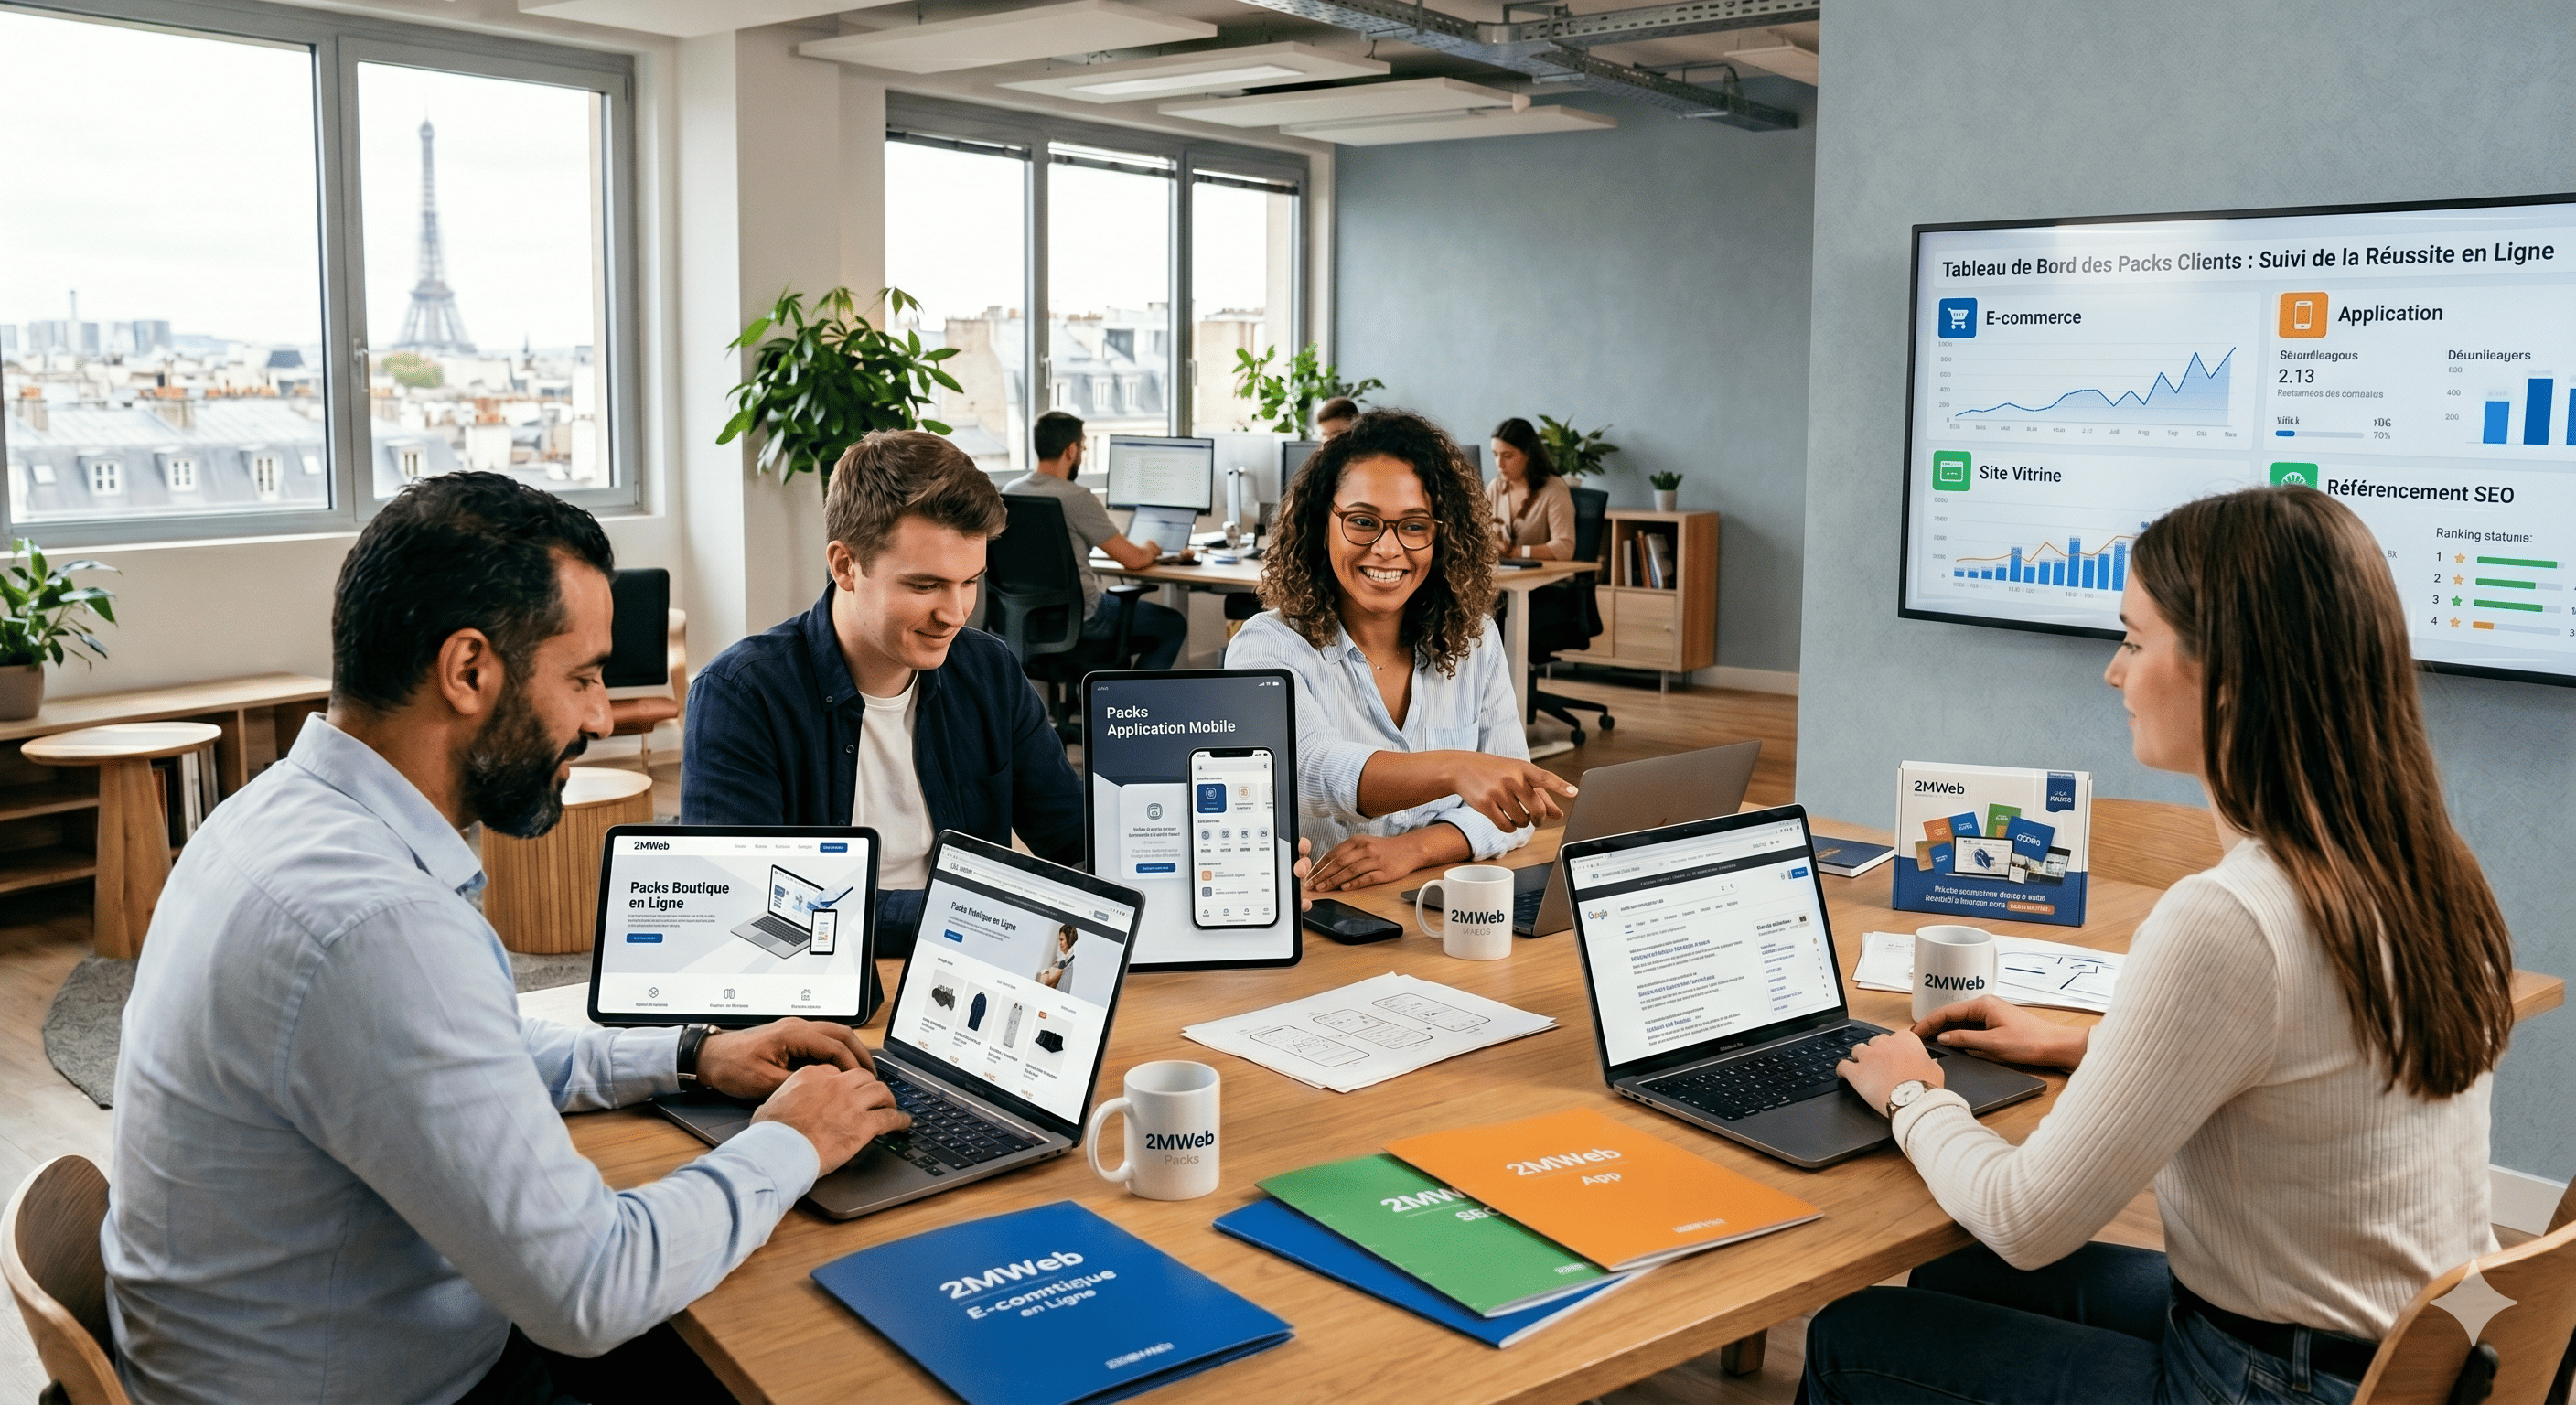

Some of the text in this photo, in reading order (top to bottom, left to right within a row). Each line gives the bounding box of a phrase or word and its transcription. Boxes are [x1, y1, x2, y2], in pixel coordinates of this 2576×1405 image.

[1943, 261, 2006, 277] Tableau
[2011, 260, 2032, 275] de
[2036, 257, 2077, 274] Bord
[2081, 256, 2112, 273] des
[2118, 254, 2172, 273] Packs
[2177, 252, 2242, 271] Clients
[2259, 249, 2306, 269] Suivi
[2313, 249, 2336, 267] de
[2342, 248, 2359, 265] la
[2366, 245, 2455, 265] Réussite
[2462, 246, 2487, 263] en
[2494, 241, 2554, 265] Ligne
[1986, 310, 2082, 325] E-commerce
[2338, 305, 2443, 327] Application
[2279, 369, 2314, 383] 2.13
[2325, 390, 2340, 398] des
[1980, 466, 2062, 483] Site Vitrine
[2327, 479, 2515, 503] Référencement SEO
[2436, 528, 2481, 542] Ranking
[2436, 552, 2442, 562] 1
[2433, 574, 2441, 583] 2
[2432, 595, 2439, 605] 3
[2431, 617, 2438, 626] 4
[1107, 706, 1149, 719] Packs
[1107, 720, 1236, 739] Application Mobile
[1914, 780, 1965, 795] 2MWeb
[634, 841, 670, 851] 2MWeb
[630, 881, 730, 896] Packs Boutique
[628, 896, 684, 912] en Ligne
[1451, 909, 1505, 925] 2MWeb
[1924, 973, 1985, 991] 2MWeb
[1145, 1130, 1215, 1150] 2MWeb
[1165, 1154, 1199, 1165] Packs
[1506, 1149, 1621, 1176] 2MWeb
[1581, 1171, 1621, 1185] App
[939, 1251, 1084, 1299] 2MWeb
[1020, 1289, 1097, 1317] en Ligne
